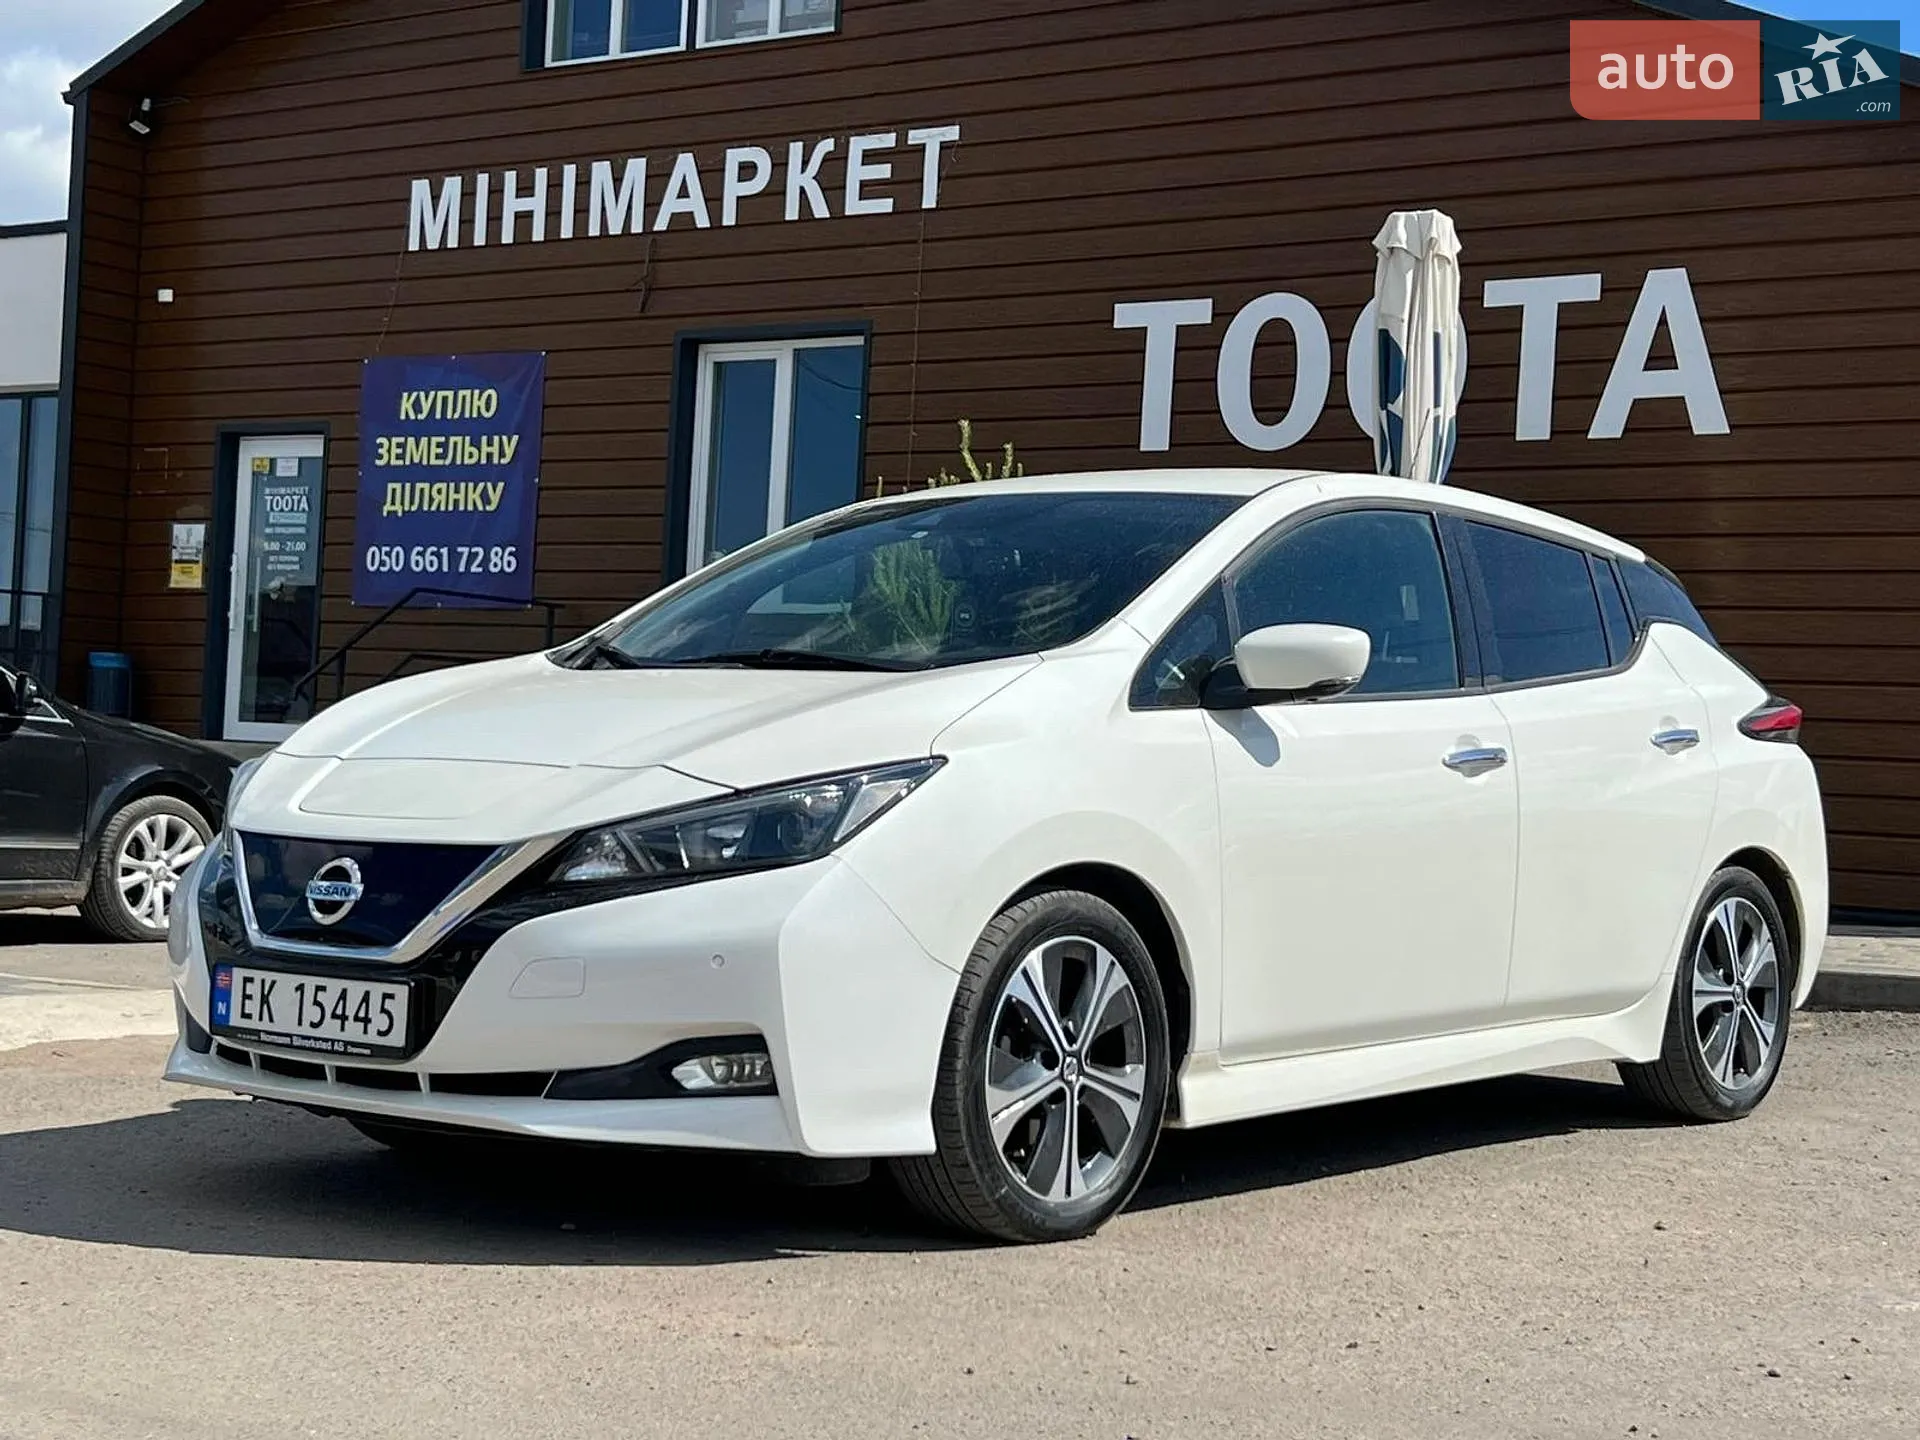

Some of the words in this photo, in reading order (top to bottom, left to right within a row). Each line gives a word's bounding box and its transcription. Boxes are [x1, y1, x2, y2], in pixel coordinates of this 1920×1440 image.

[407, 125, 961, 252] МІНІМАРКЕТ
[400, 388, 498, 420] КУПЛЮ
[374, 435, 520, 467] ЗЕМЕЛЬНУ
[264, 495, 309, 512] ТООТА
[382, 481, 505, 517] ДІЛЯНКУ
[366, 546, 405, 573] 050
[410, 546, 449, 573] 661
[457, 547, 484, 573] 72
[489, 546, 518, 573] 86
[309, 885, 352, 897] NISSAN
[217, 1002, 227, 1016] N
[240, 976, 277, 1024] EK
[294, 982, 396, 1038] 15445
